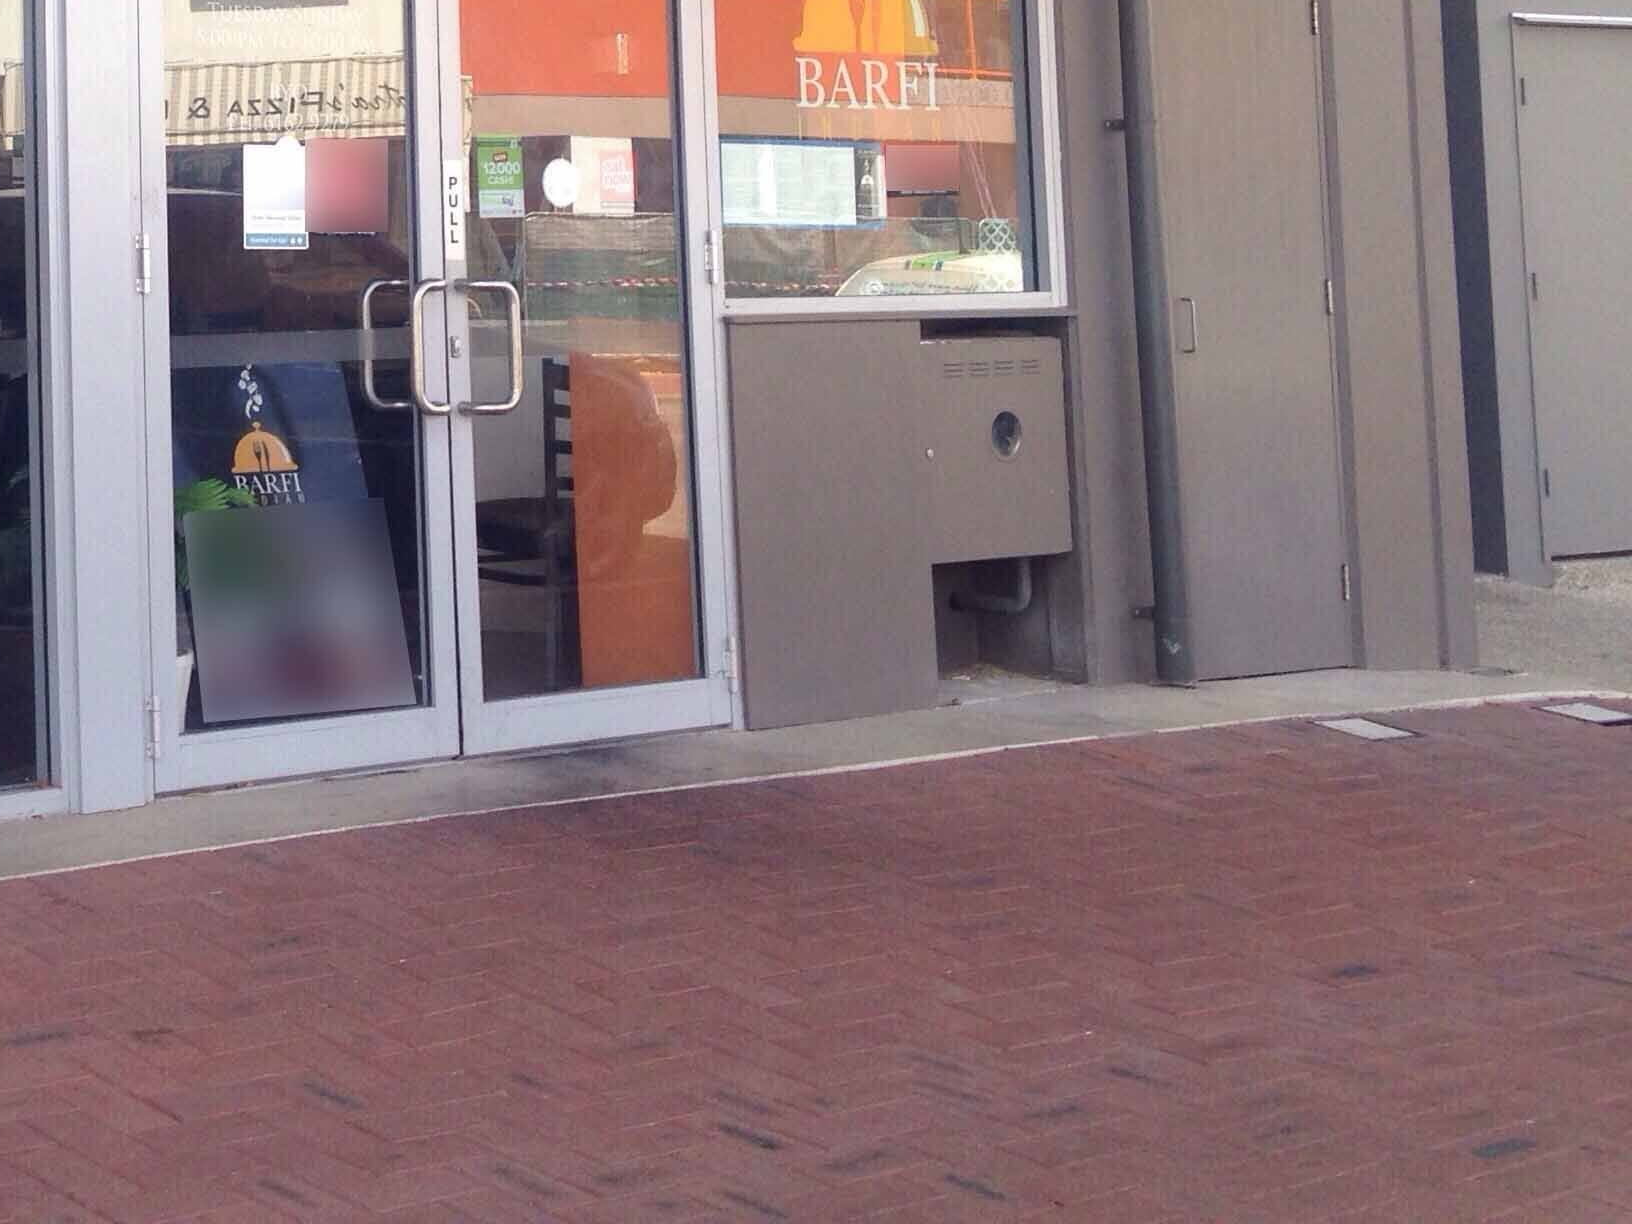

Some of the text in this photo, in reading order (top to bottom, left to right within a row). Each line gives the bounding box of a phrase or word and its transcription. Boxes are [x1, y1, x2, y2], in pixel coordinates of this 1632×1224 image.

[795, 55, 941, 111] BARFI
[447, 176, 460, 244] PULL
[234, 472, 303, 495] BARFI
